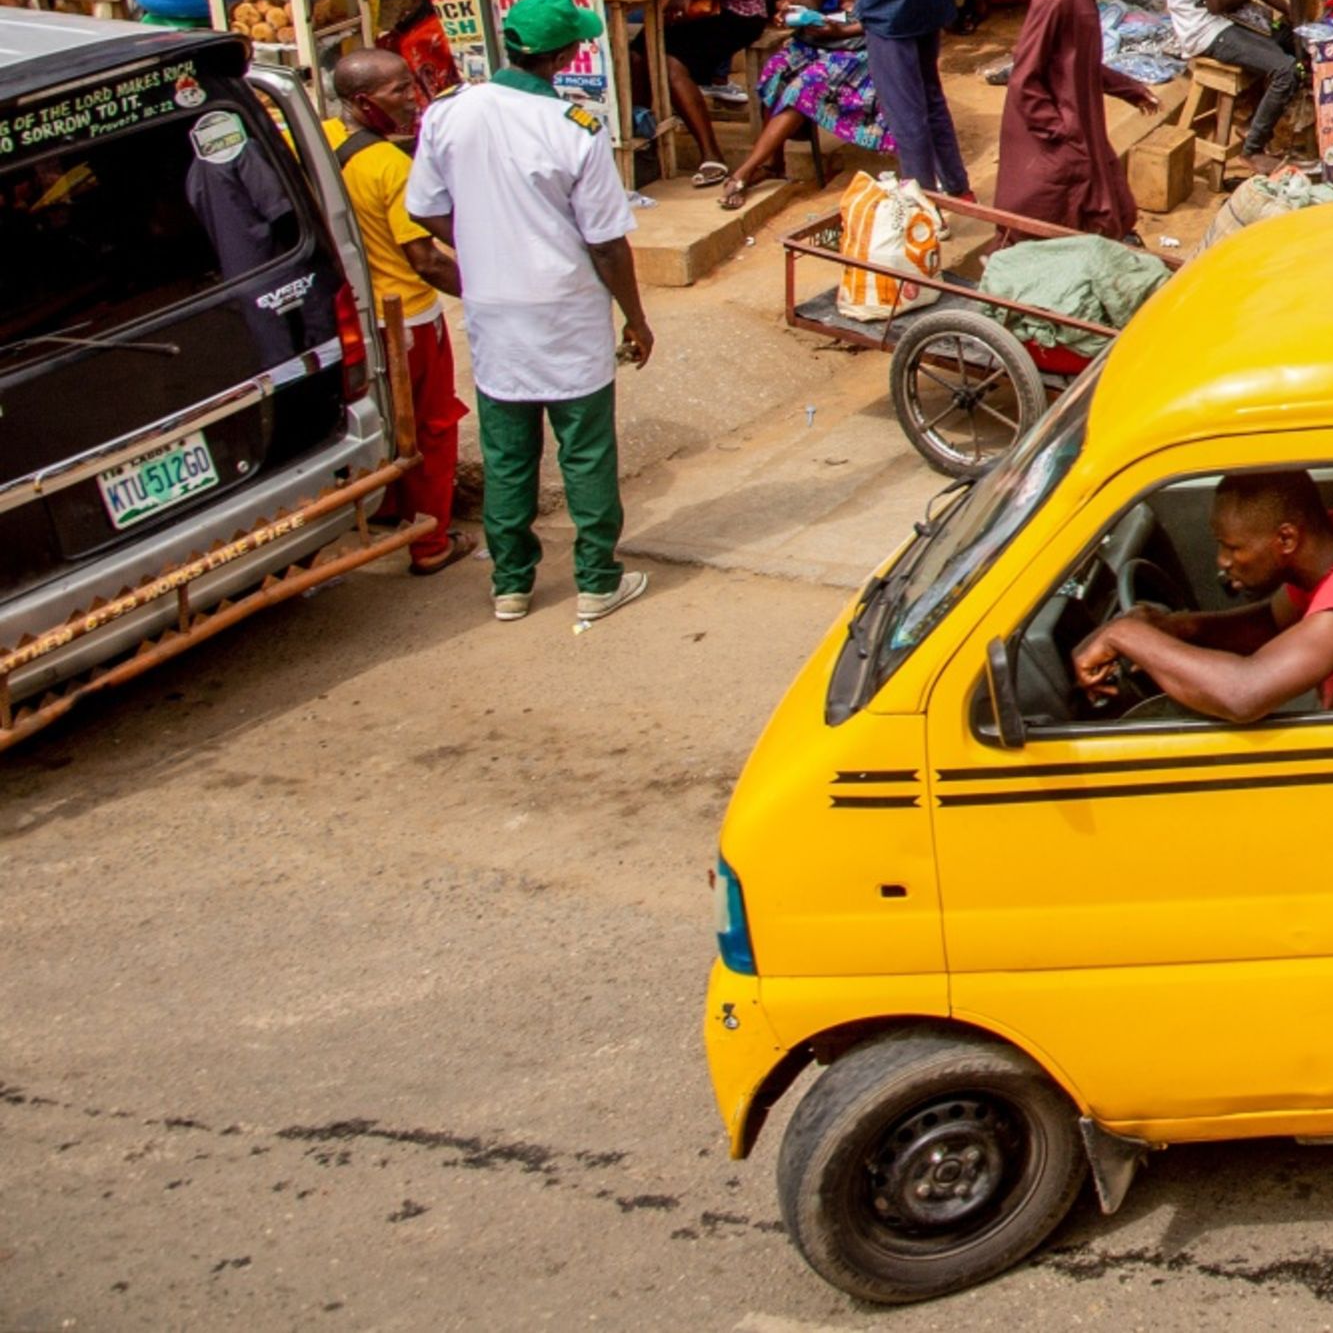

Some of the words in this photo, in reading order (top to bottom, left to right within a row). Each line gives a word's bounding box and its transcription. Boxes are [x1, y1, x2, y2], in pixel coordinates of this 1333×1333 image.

[14, 113, 36, 129] OF
[42, 102, 71, 123] THE
[75, 88, 112, 116] LORD
[117, 73, 160, 99] MAKES
[21, 113, 91, 145] SORROW
[97, 103, 118, 119] TO
[121, 94, 142, 114] IT.
[207, 542, 250, 571] LIKE
[254, 512, 306, 547] FIRE
